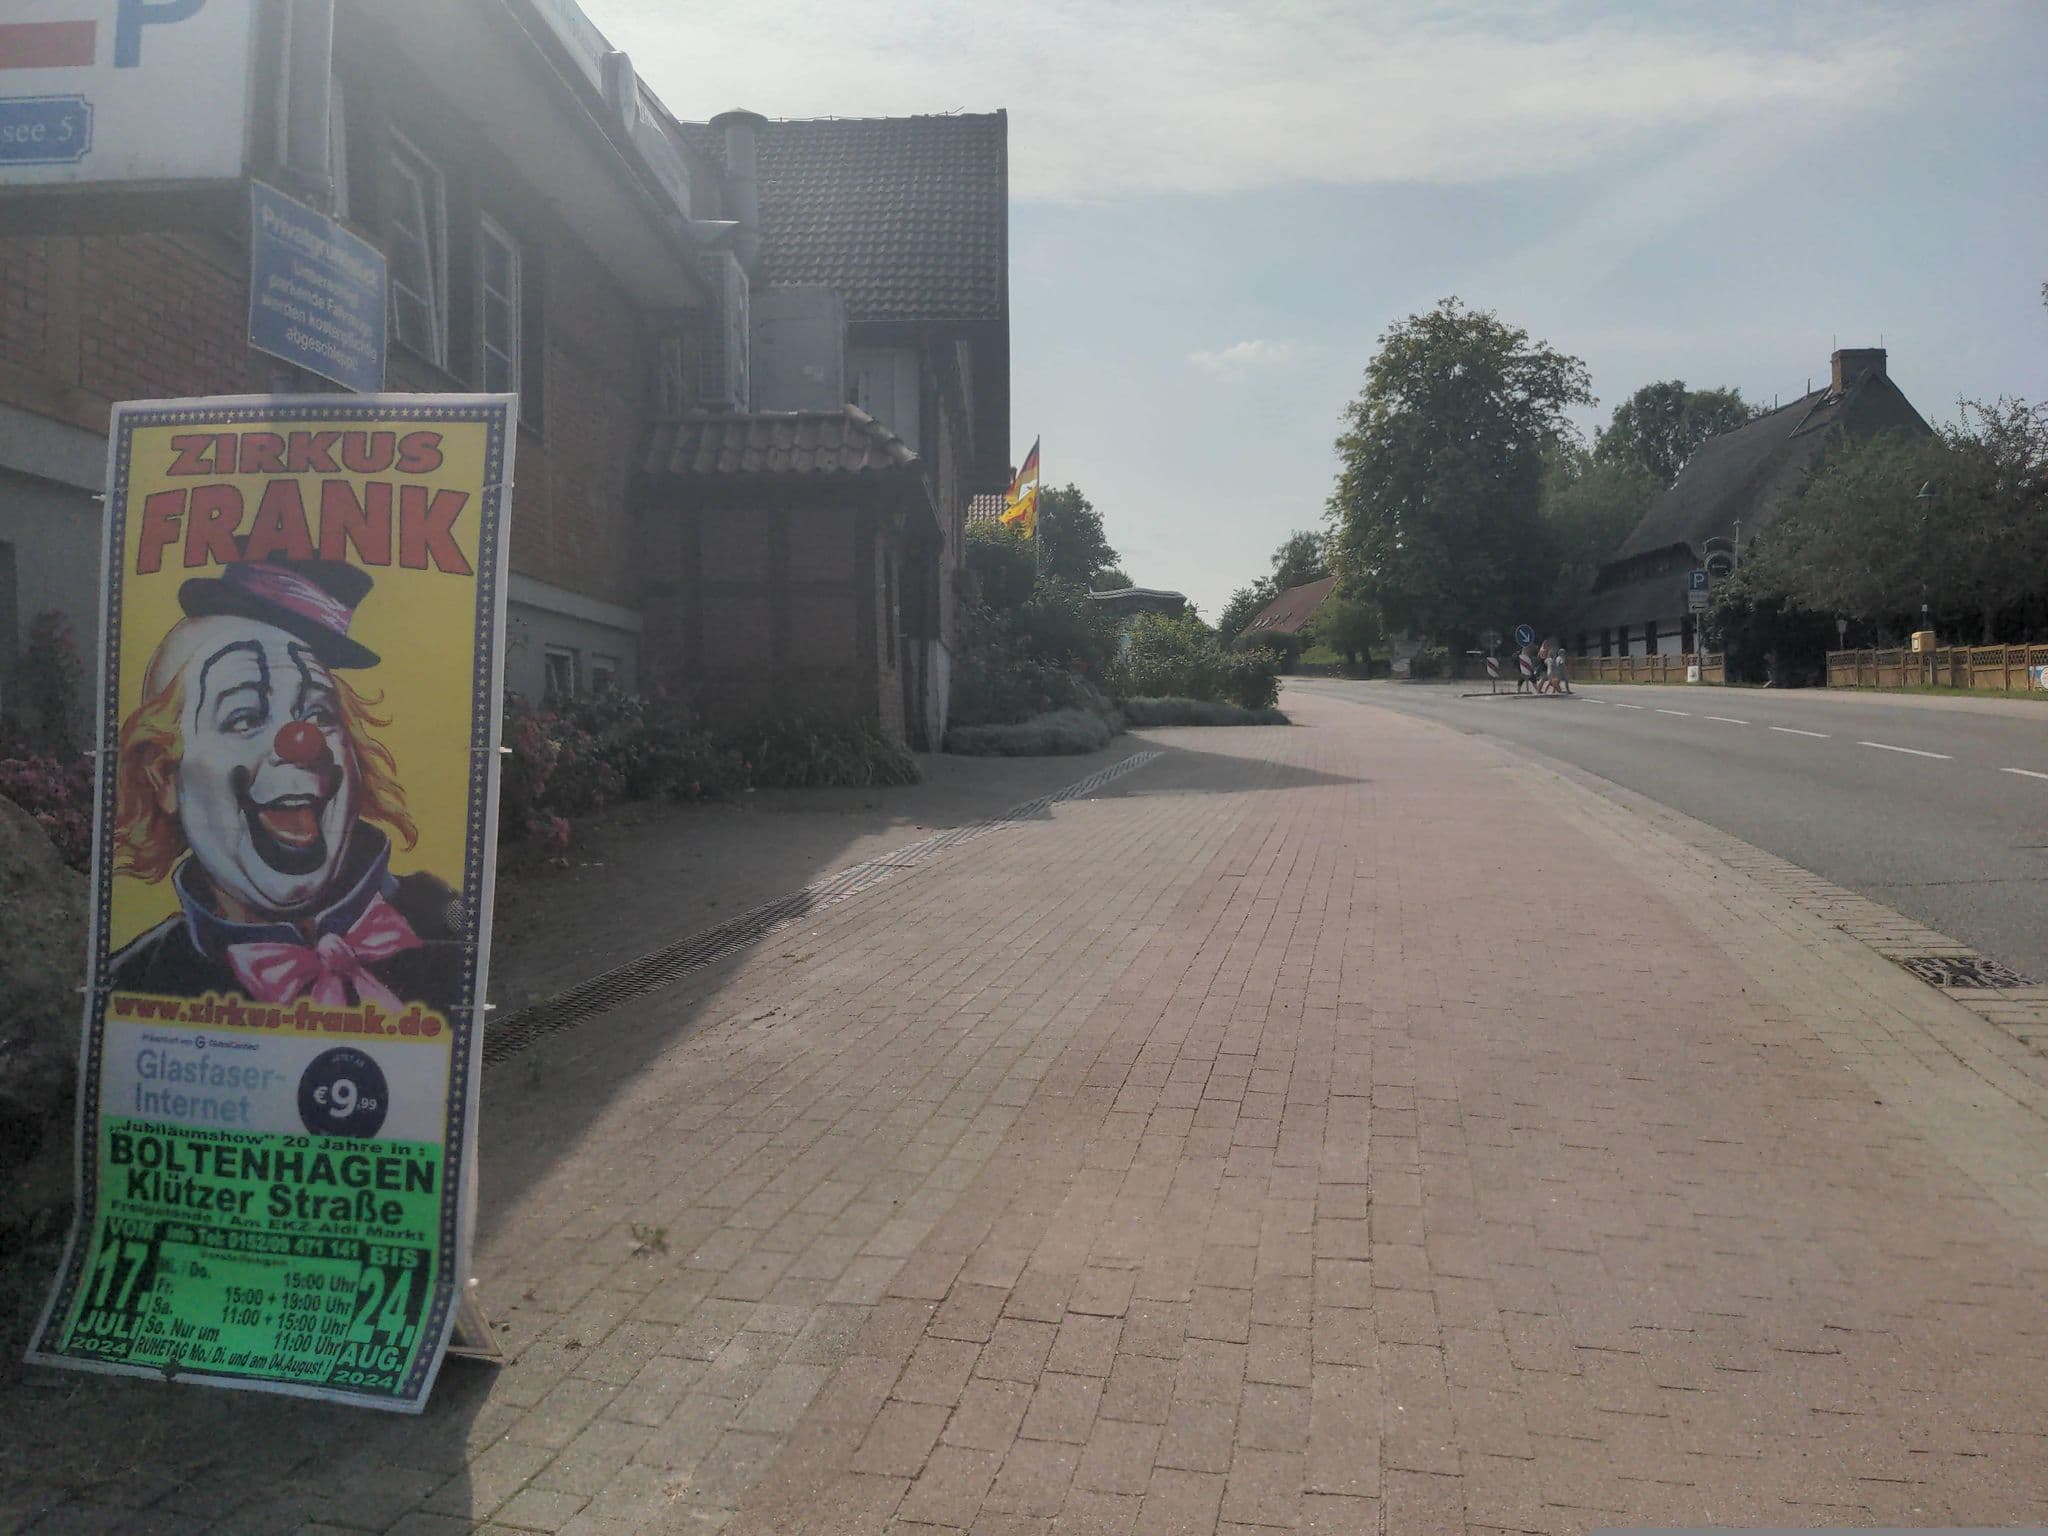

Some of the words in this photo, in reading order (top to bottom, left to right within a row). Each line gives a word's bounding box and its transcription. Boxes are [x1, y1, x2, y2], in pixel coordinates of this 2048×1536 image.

[56, 116, 74, 142] 5
[166, 431, 444, 476] ZIRKUS
[136, 479, 474, 575] FRANK
[1693, 573, 1705, 588] P
[114, 995, 442, 1037] www.zirkus-frank.de
[136, 1049, 287, 1089] Glasfaser-
[135, 1082, 252, 1124] Internet
[318, 1138, 383, 1154] Jahre
[110, 1133, 435, 1194] BOLTENHAGEN
[127, 1168, 256, 1214] Klützer
[267, 1183, 404, 1225] Straße
[370, 1246, 419, 1267] BIS
[330, 1275, 358, 1294] Uhr
[152, 1296, 174, 1315] Sa.
[222, 1306, 260, 1326] 11:00
[278, 1312, 317, 1332] 15:00
[321, 1316, 348, 1336] Uhr
[225, 1286, 264, 1305] 15:00
[326, 1295, 353, 1315] Uhr
[77, 1309, 144, 1339] JULI
[170, 1318, 197, 1339] Nur
[197, 1324, 219, 1343] um
[274, 1333, 312, 1352] 11:00
[315, 1337, 341, 1356] Uhr
[70, 1338, 128, 1354] 2024
[134, 1336, 188, 1359] RUHETAG
[227, 1351, 247, 1367] und
[249, 1354, 267, 1368] am
[336, 1343, 403, 1373] AUG.
[332, 1369, 394, 1387] 2024
